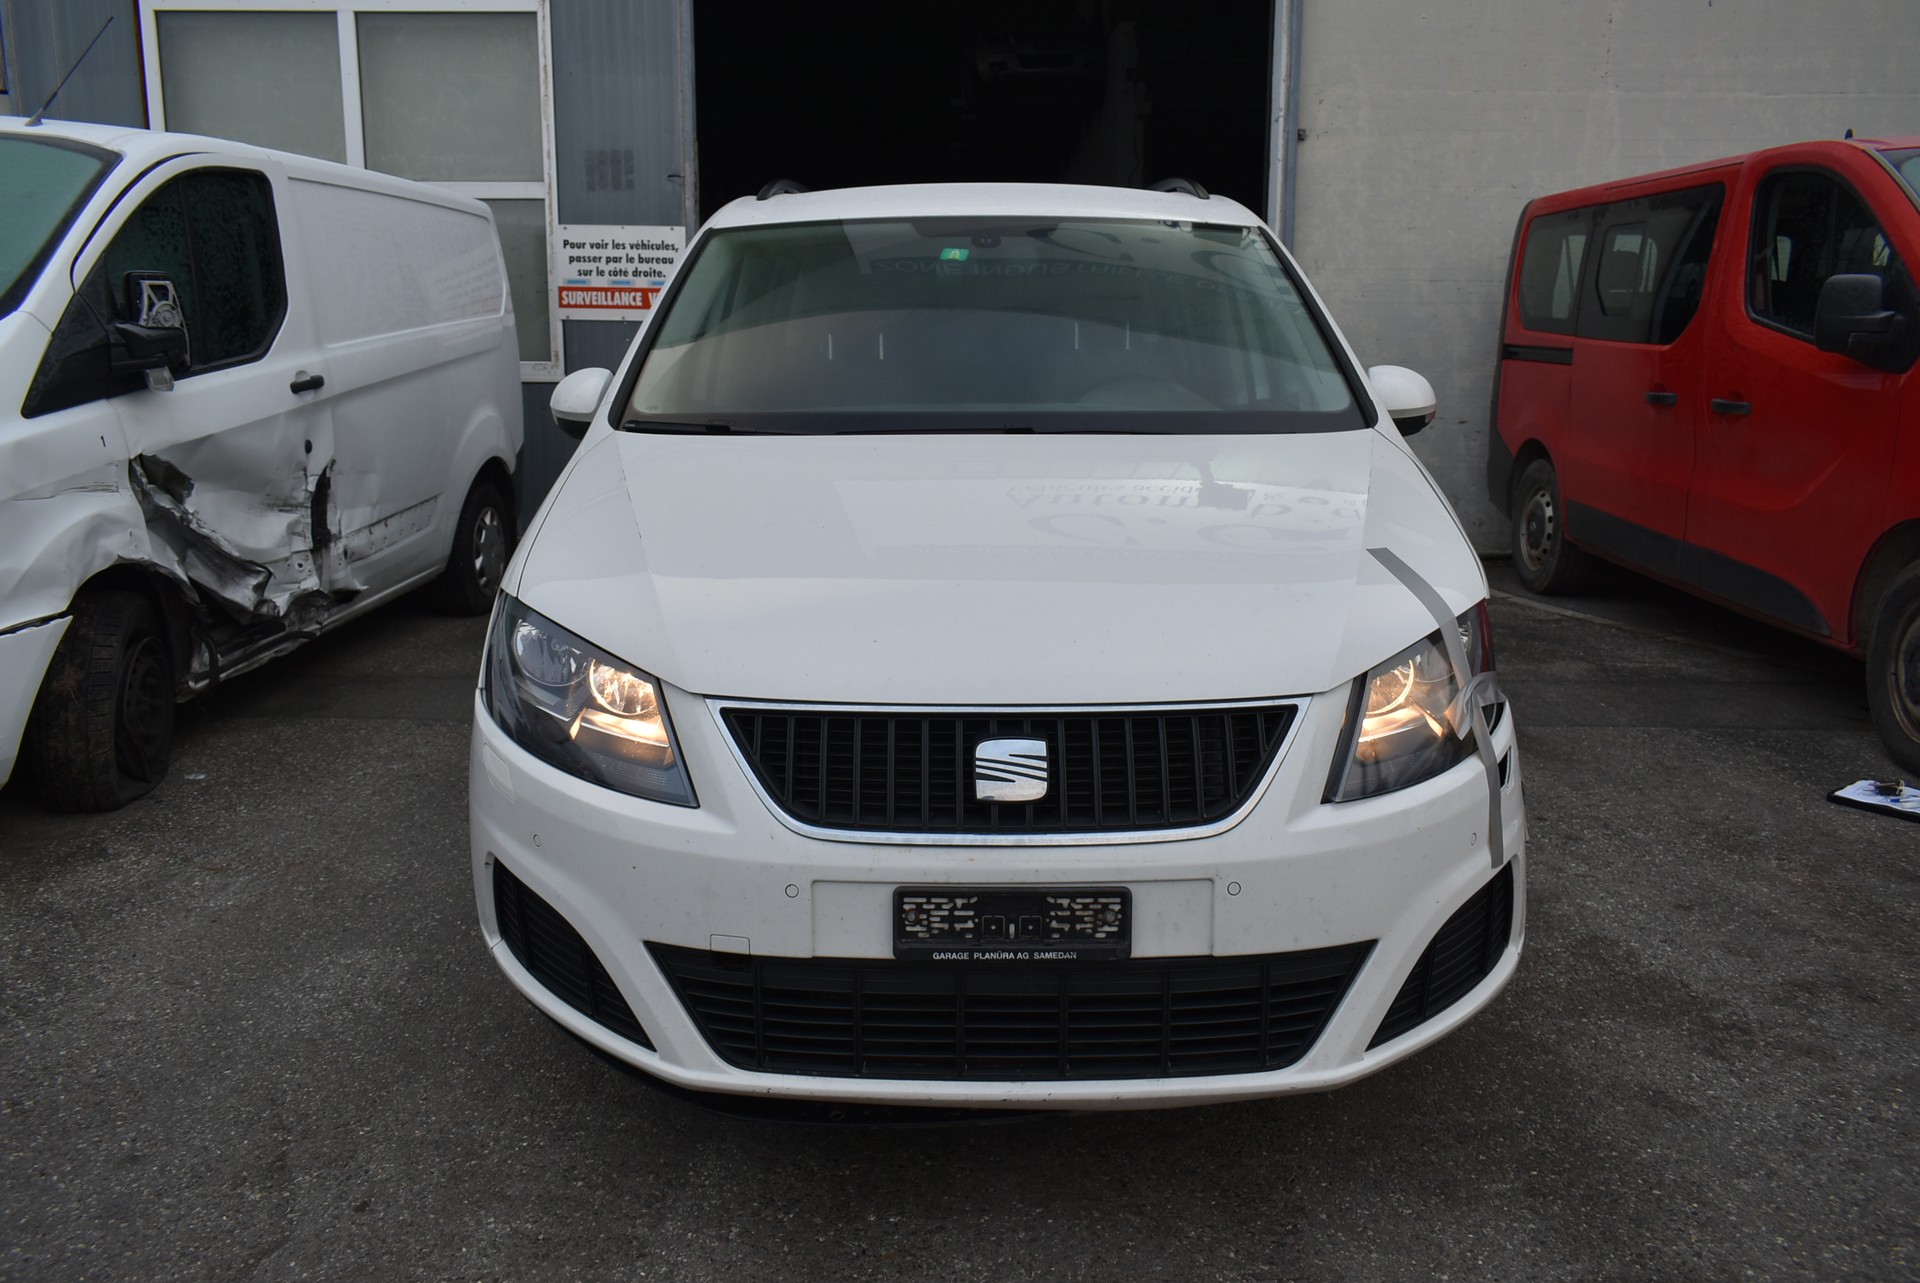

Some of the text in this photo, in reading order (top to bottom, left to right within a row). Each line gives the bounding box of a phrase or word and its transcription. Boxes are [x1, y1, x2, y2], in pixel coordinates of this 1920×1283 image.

[563, 239, 679, 253] Pour voir les véhicules,
[568, 253, 674, 265] passer par le bureau
[577, 268, 593, 277] sur
[596, 266, 606, 277] le
[632, 267, 666, 279] droite.
[562, 290, 642, 306] SURVEILLANCE
[932, 951, 970, 960] GARAGE
[1016, 951, 1030, 960] AG
[1033, 951, 1077, 960] SAMEDAN
